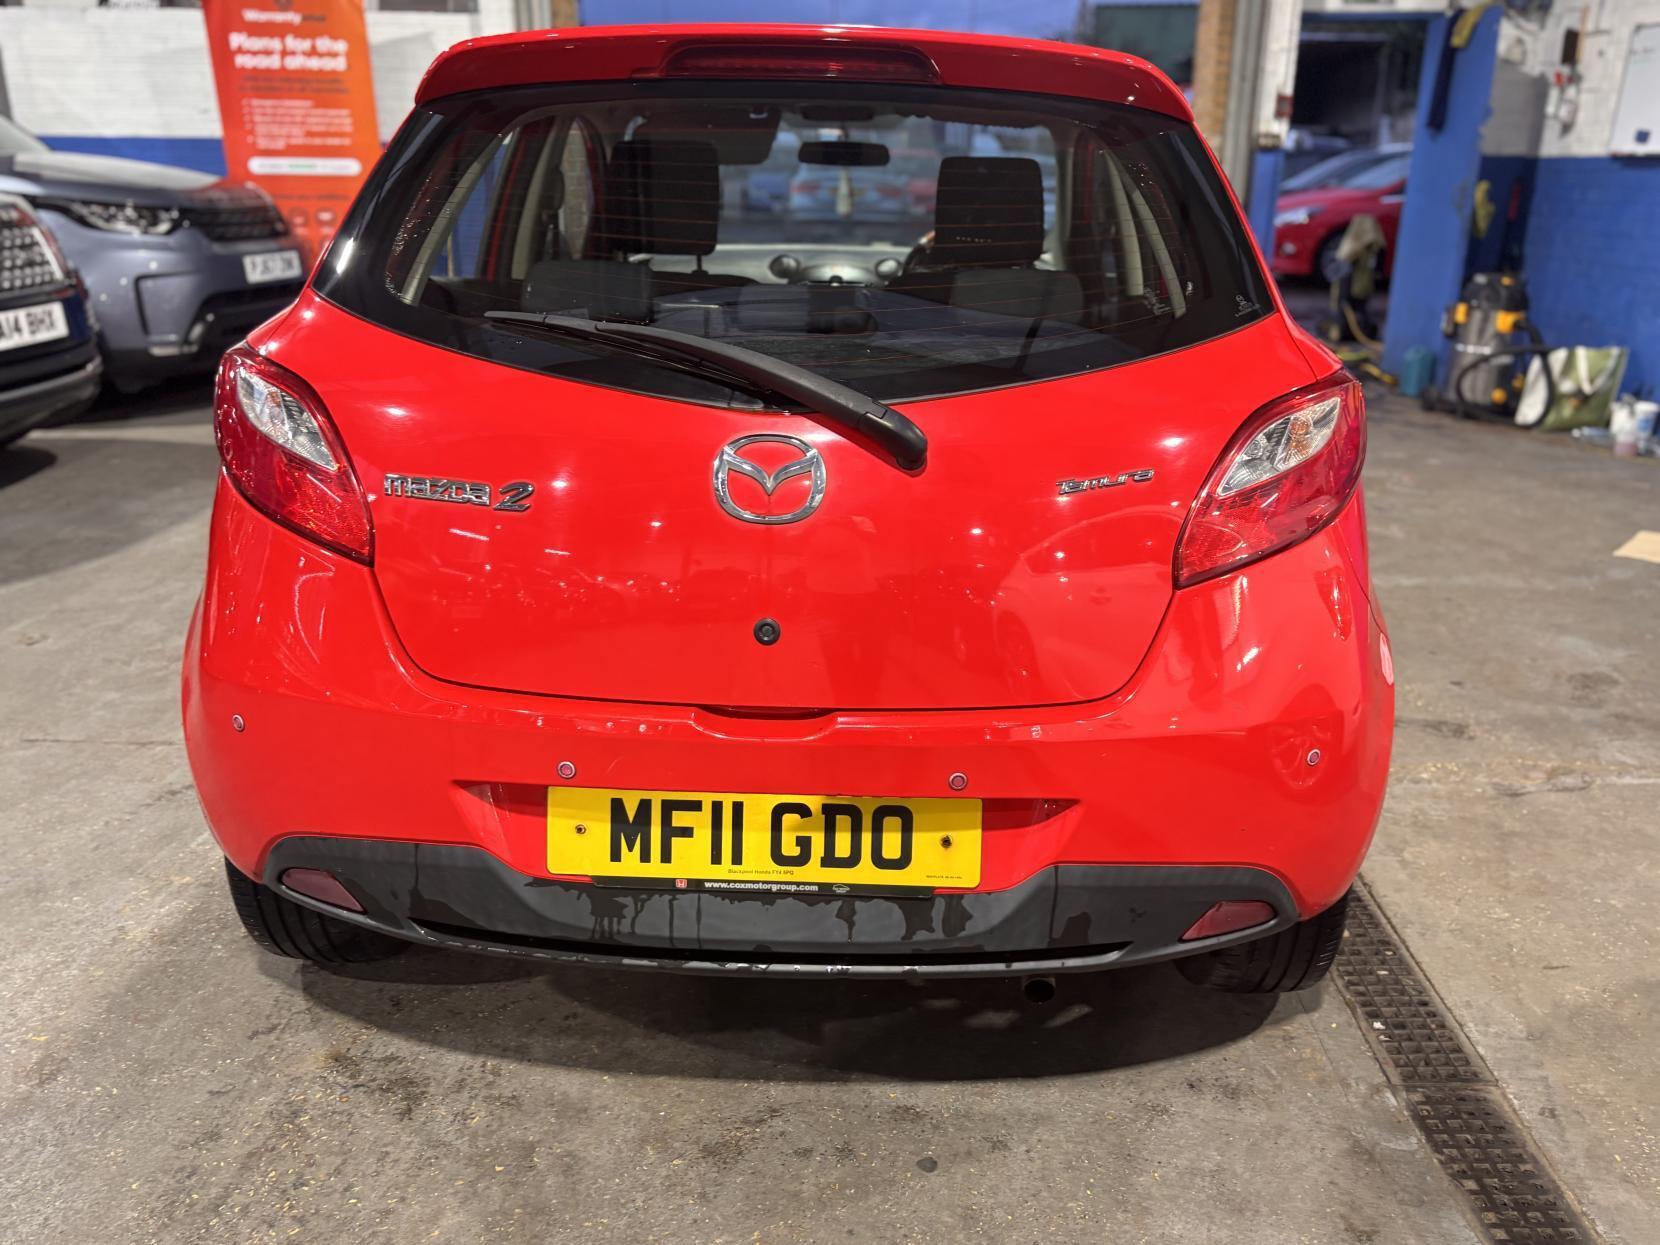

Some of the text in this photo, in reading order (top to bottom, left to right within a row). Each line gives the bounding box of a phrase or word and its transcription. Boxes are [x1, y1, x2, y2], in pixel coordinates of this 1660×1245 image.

[229, 32, 348, 54] Plans for the
[235, 54, 348, 72] road ahead
[609, 797, 915, 871] MF11 GDO
[704, 881, 819, 892] www.coxmotorgroup.com
